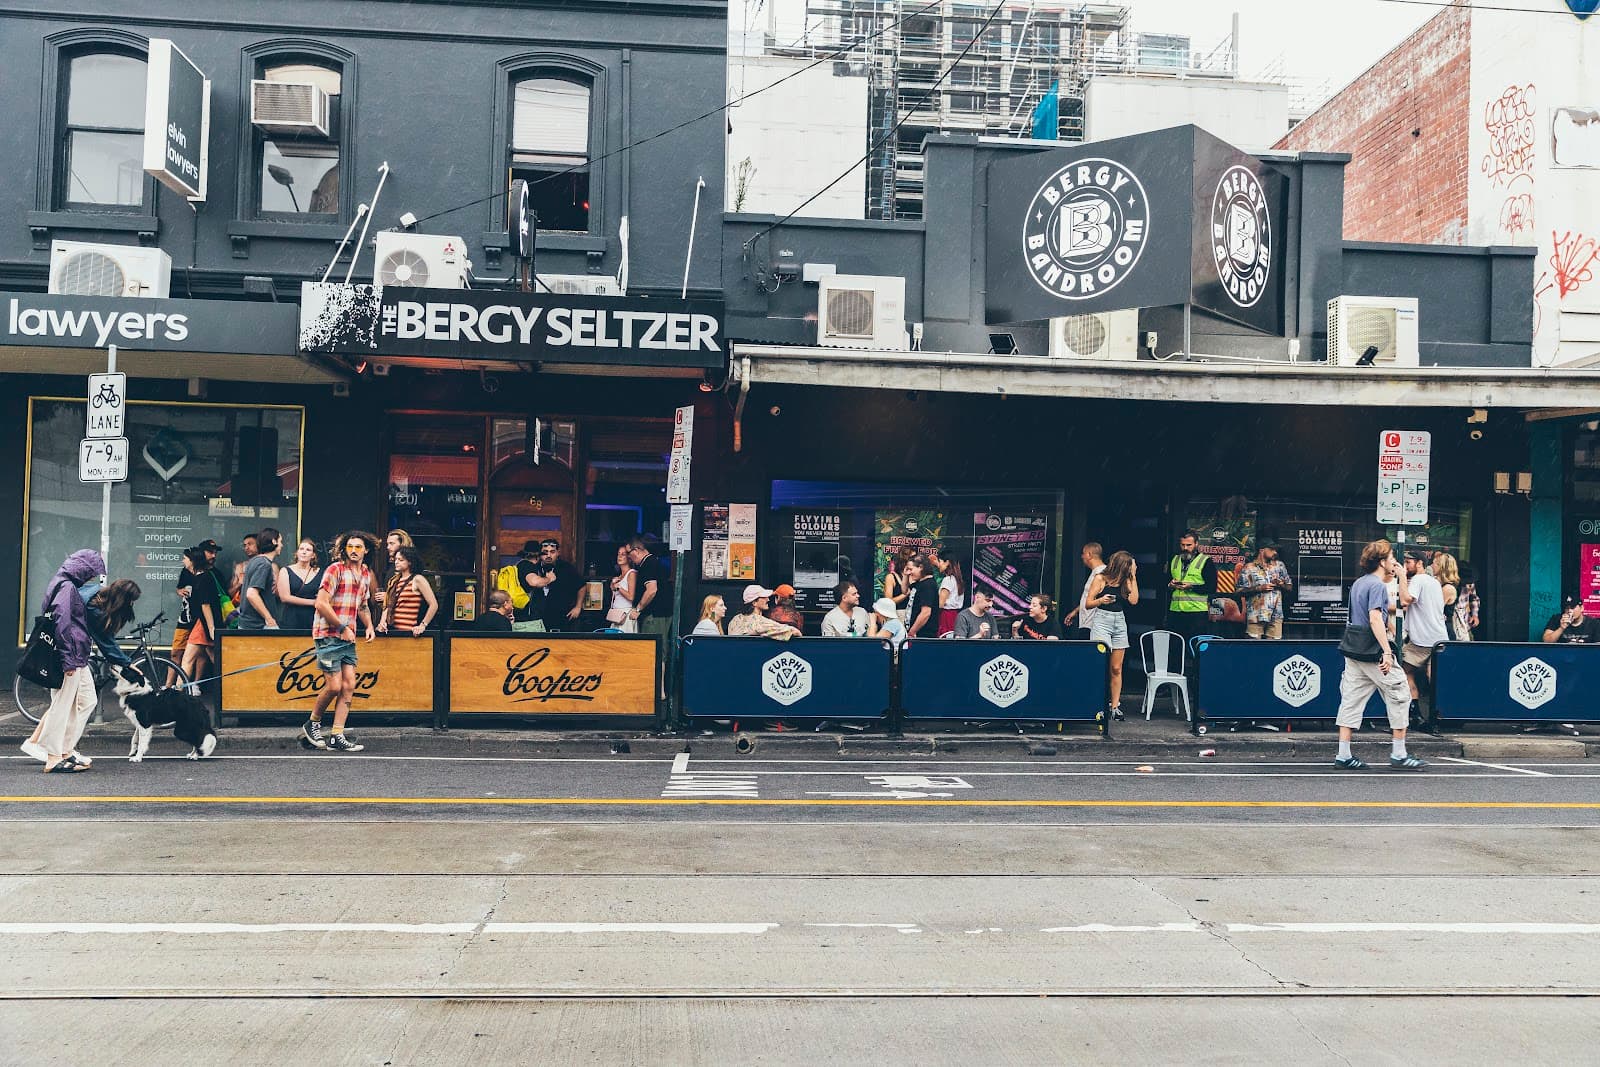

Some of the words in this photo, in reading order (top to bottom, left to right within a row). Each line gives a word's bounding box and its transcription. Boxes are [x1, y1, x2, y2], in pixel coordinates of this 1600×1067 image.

[168, 122, 186, 148] elvin
[166, 140, 198, 180] lawyers
[1043, 165, 1130, 206] BERGY
[1222, 172, 1265, 212] BERGY
[1028, 219, 1144, 294] BANDROOM
[1214, 223, 1269, 302] BANDROOM
[8, 298, 188, 347] lawyers
[382, 304, 396, 336] THE
[396, 300, 543, 345] BERGY
[546, 307, 722, 352] SELTZER
[91, 414, 120, 430] LANE
[85, 444, 113, 463] 7-9
[138, 514, 191, 523] commercial
[794, 514, 840, 523] FLYYING
[794, 523, 840, 531] COLOURS
[1299, 529, 1342, 538] FLYYING
[144, 533, 182, 544] property
[978, 533, 1023, 544] SYDNEY
[146, 552, 180, 561] divorce
[146, 572, 178, 580] estates
[768, 658, 806, 674] FURPHY
[985, 661, 1023, 677] FURPHY
[1279, 661, 1316, 677] FURPHY
[1515, 664, 1552, 679] FURPHY
[502, 648, 604, 702] Coopers
